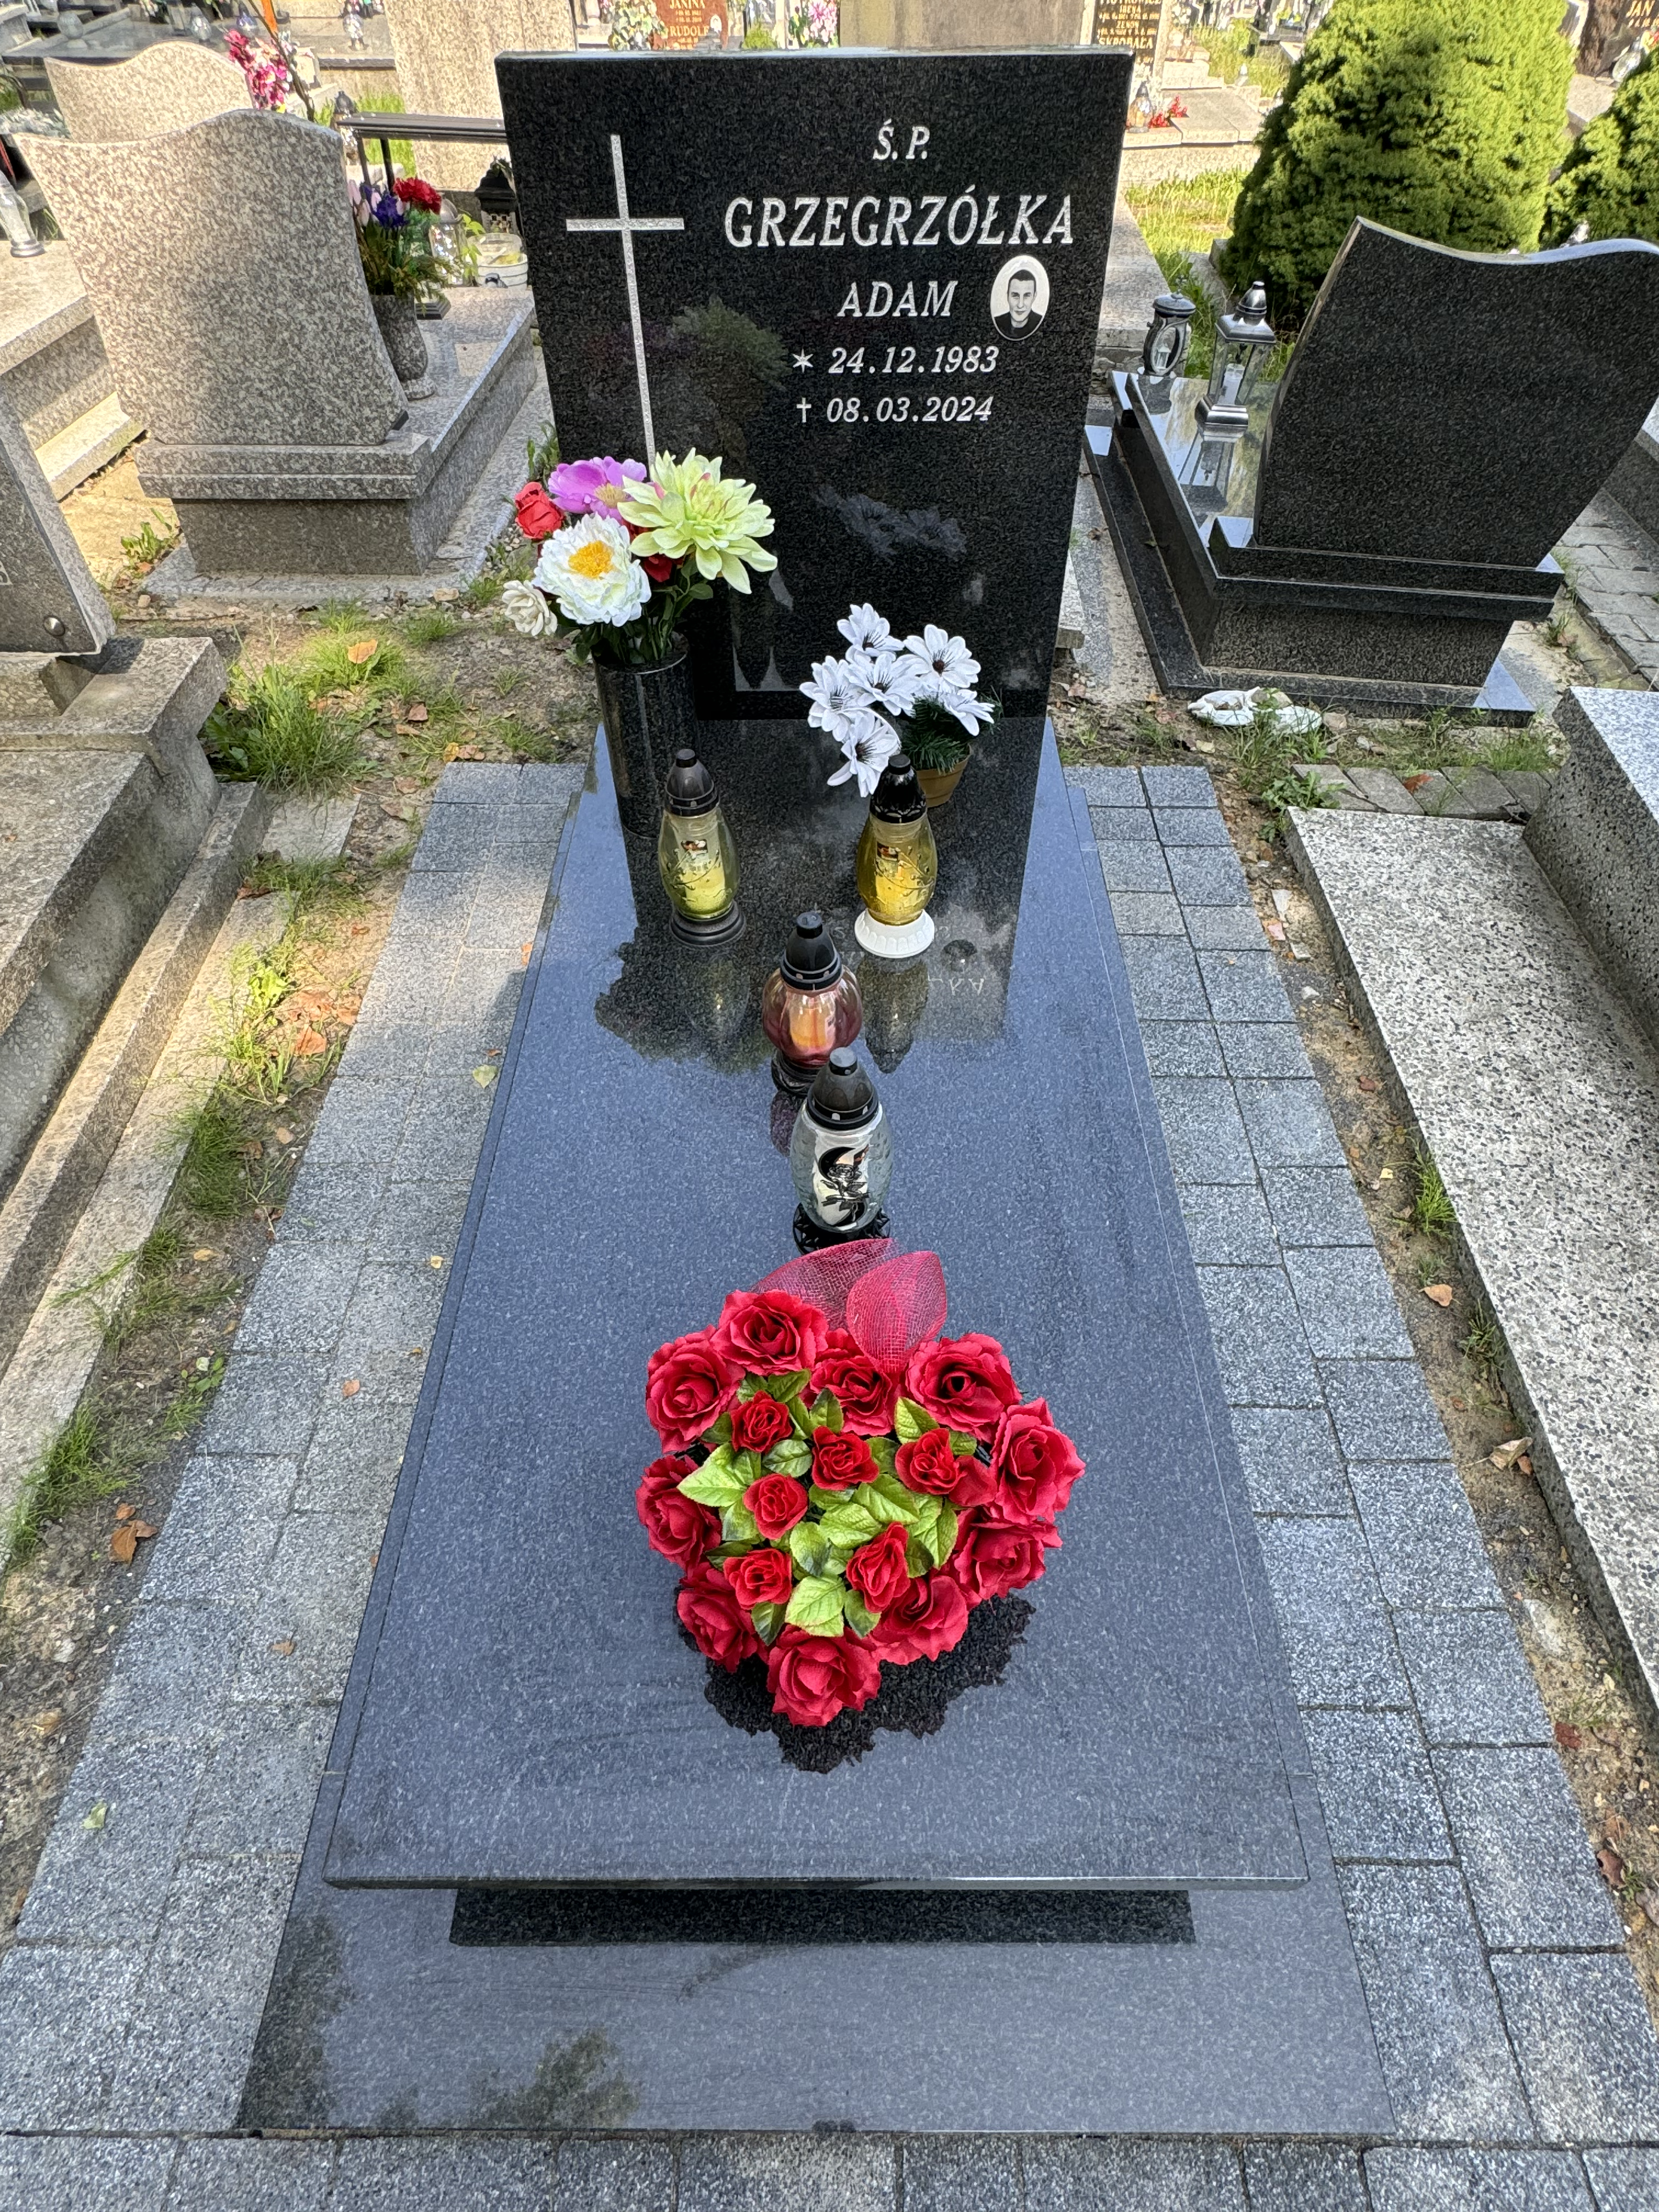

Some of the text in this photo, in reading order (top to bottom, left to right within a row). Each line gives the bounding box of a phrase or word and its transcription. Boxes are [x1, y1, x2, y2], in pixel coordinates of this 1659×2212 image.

[669, 25, 709, 36] RUDOLF
[724, 184, 1074, 247] GRZEGRZÓŁKA
[837, 280, 958, 317] ADAM
[828, 346, 1000, 374] 24.12.1983
[826, 396, 994, 422] 08.03.2024
